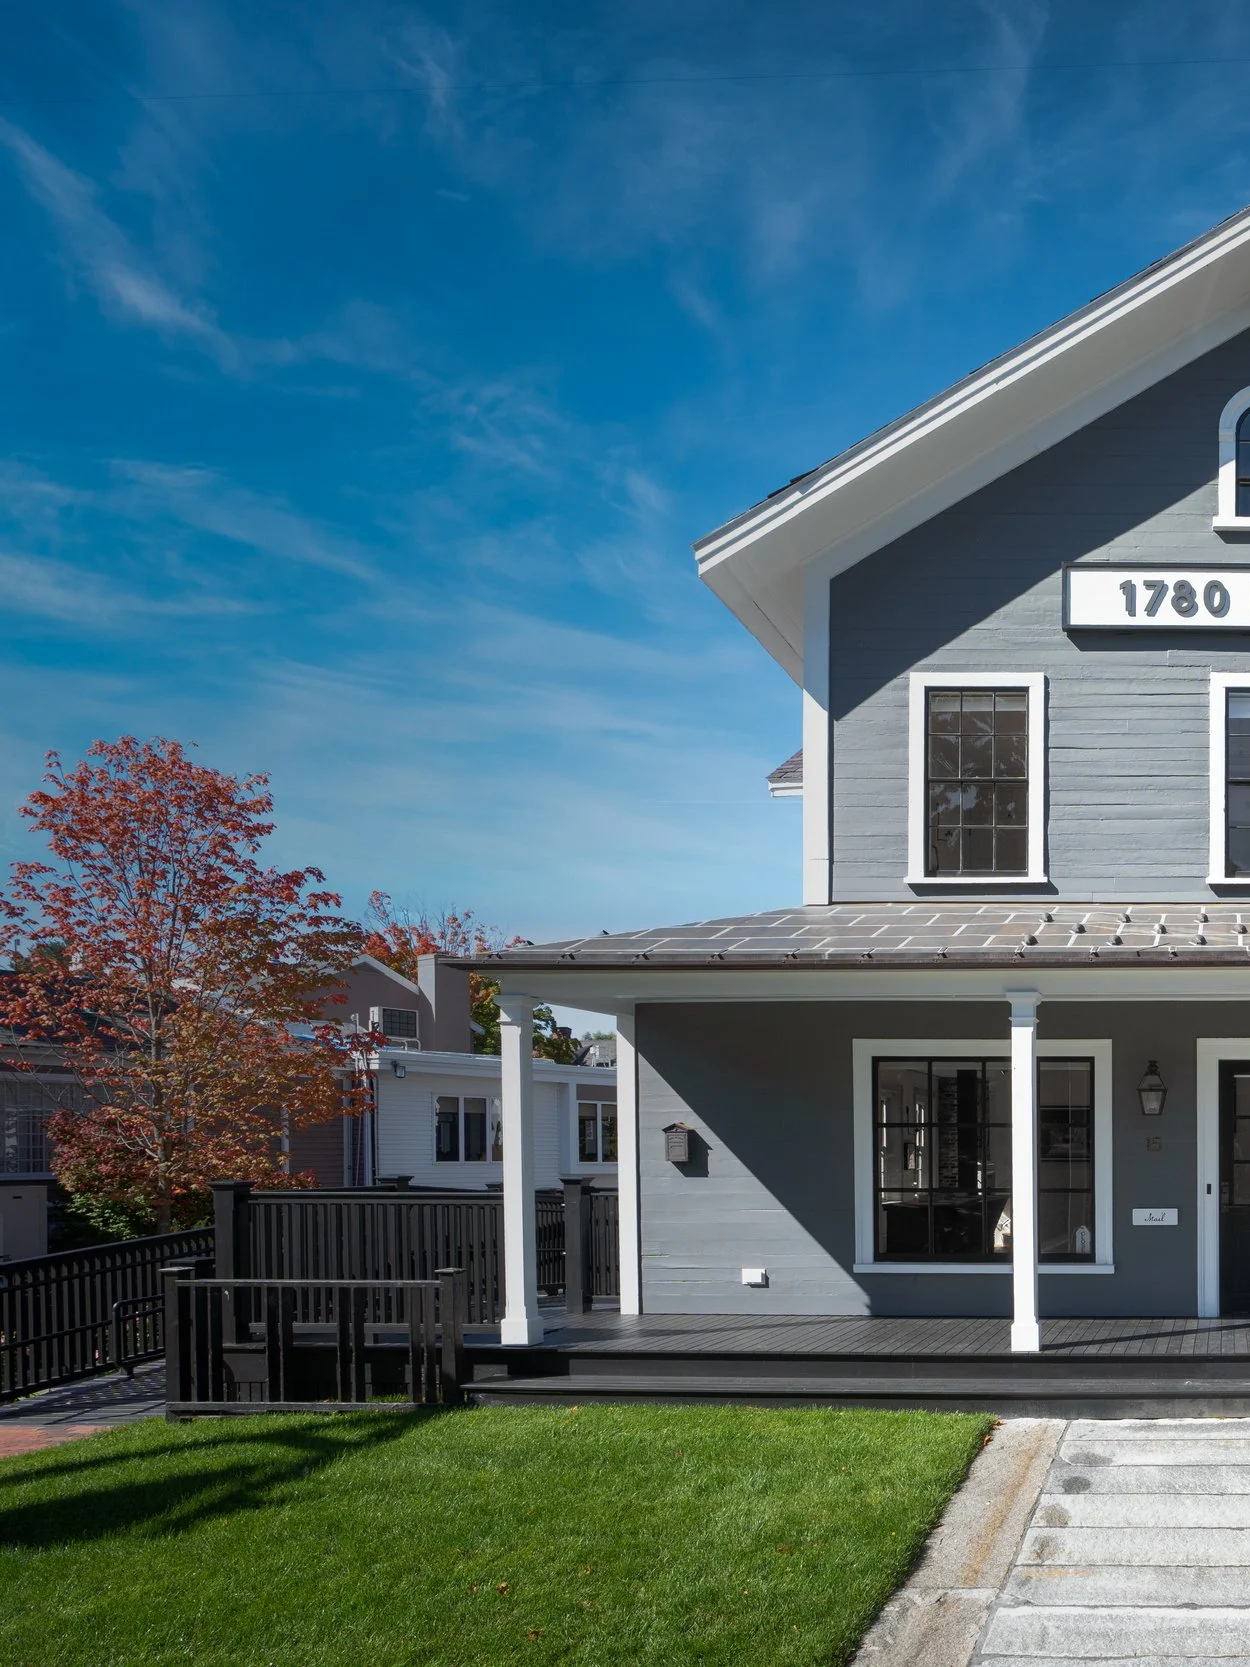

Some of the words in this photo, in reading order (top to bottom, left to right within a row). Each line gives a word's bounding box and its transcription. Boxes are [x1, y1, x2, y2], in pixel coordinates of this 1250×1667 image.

[1119, 579, 1227, 617] 1780
[1144, 1136, 1162, 1152] 15
[1144, 1212, 1166, 1222] Mail
